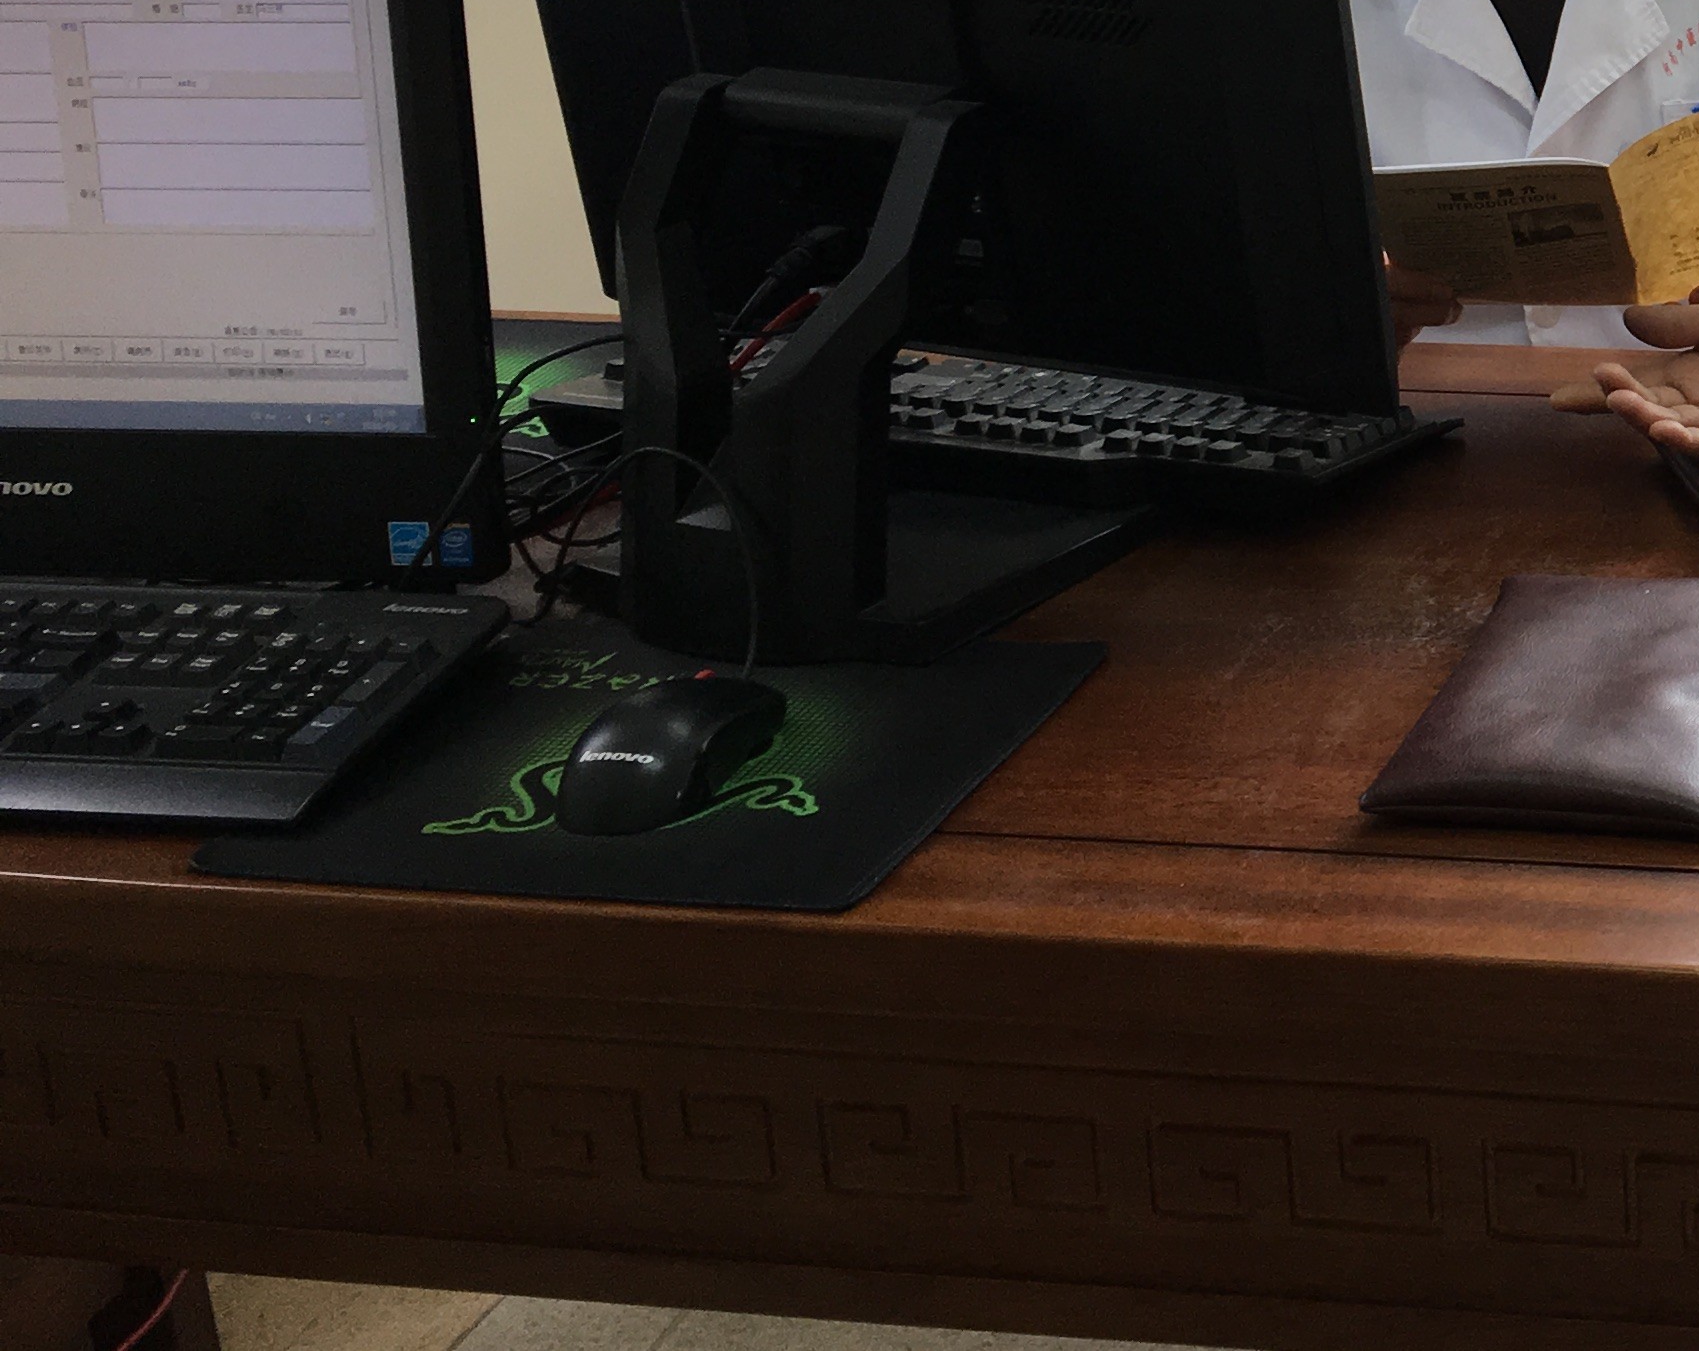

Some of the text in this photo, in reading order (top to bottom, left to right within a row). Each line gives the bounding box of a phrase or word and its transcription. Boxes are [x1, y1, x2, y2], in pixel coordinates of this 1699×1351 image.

[1437, 192, 1557, 211] INTRODUCTION
[382, 602, 469, 615] lenovo
[578, 750, 655, 764] lenovo
